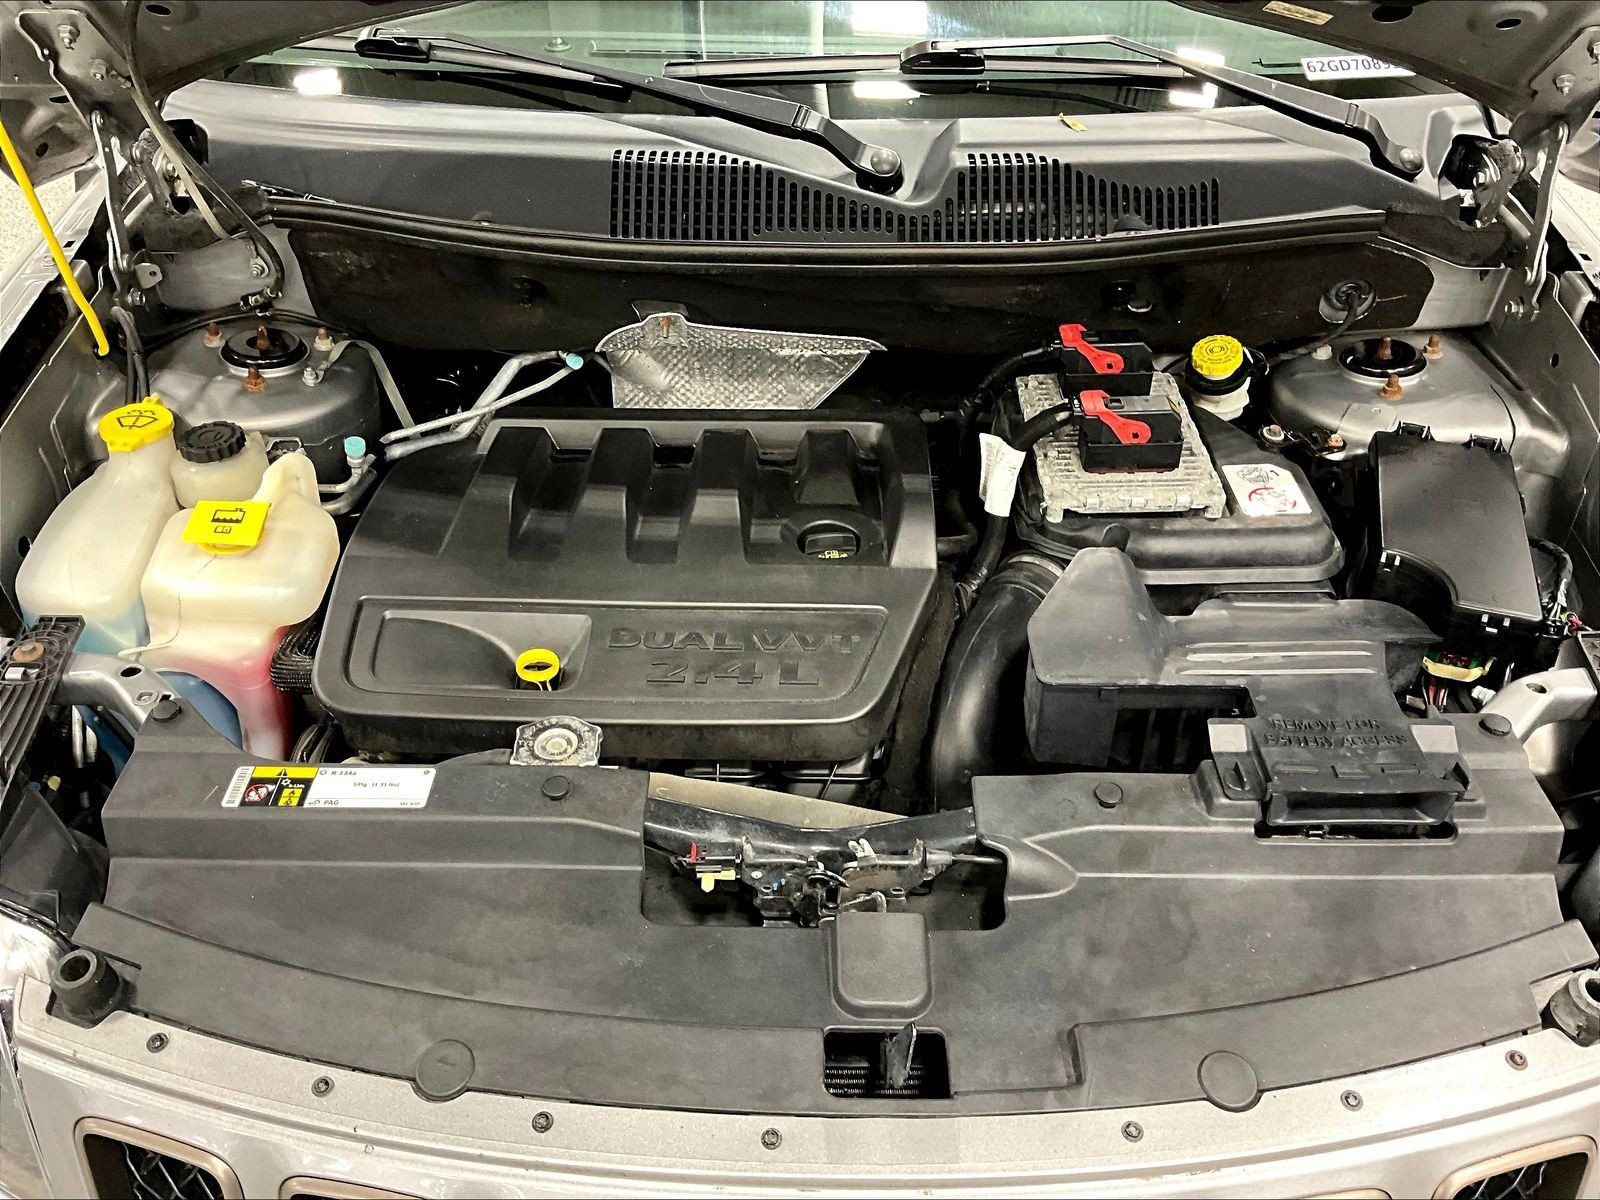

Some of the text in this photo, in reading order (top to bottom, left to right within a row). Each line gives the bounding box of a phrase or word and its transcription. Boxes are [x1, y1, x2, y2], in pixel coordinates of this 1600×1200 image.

[607, 627, 861, 652] DUAL VVT
[1270, 718, 1381, 731] REMOVE FOR
[1263, 733, 1408, 748] BATTERY ACCESS
